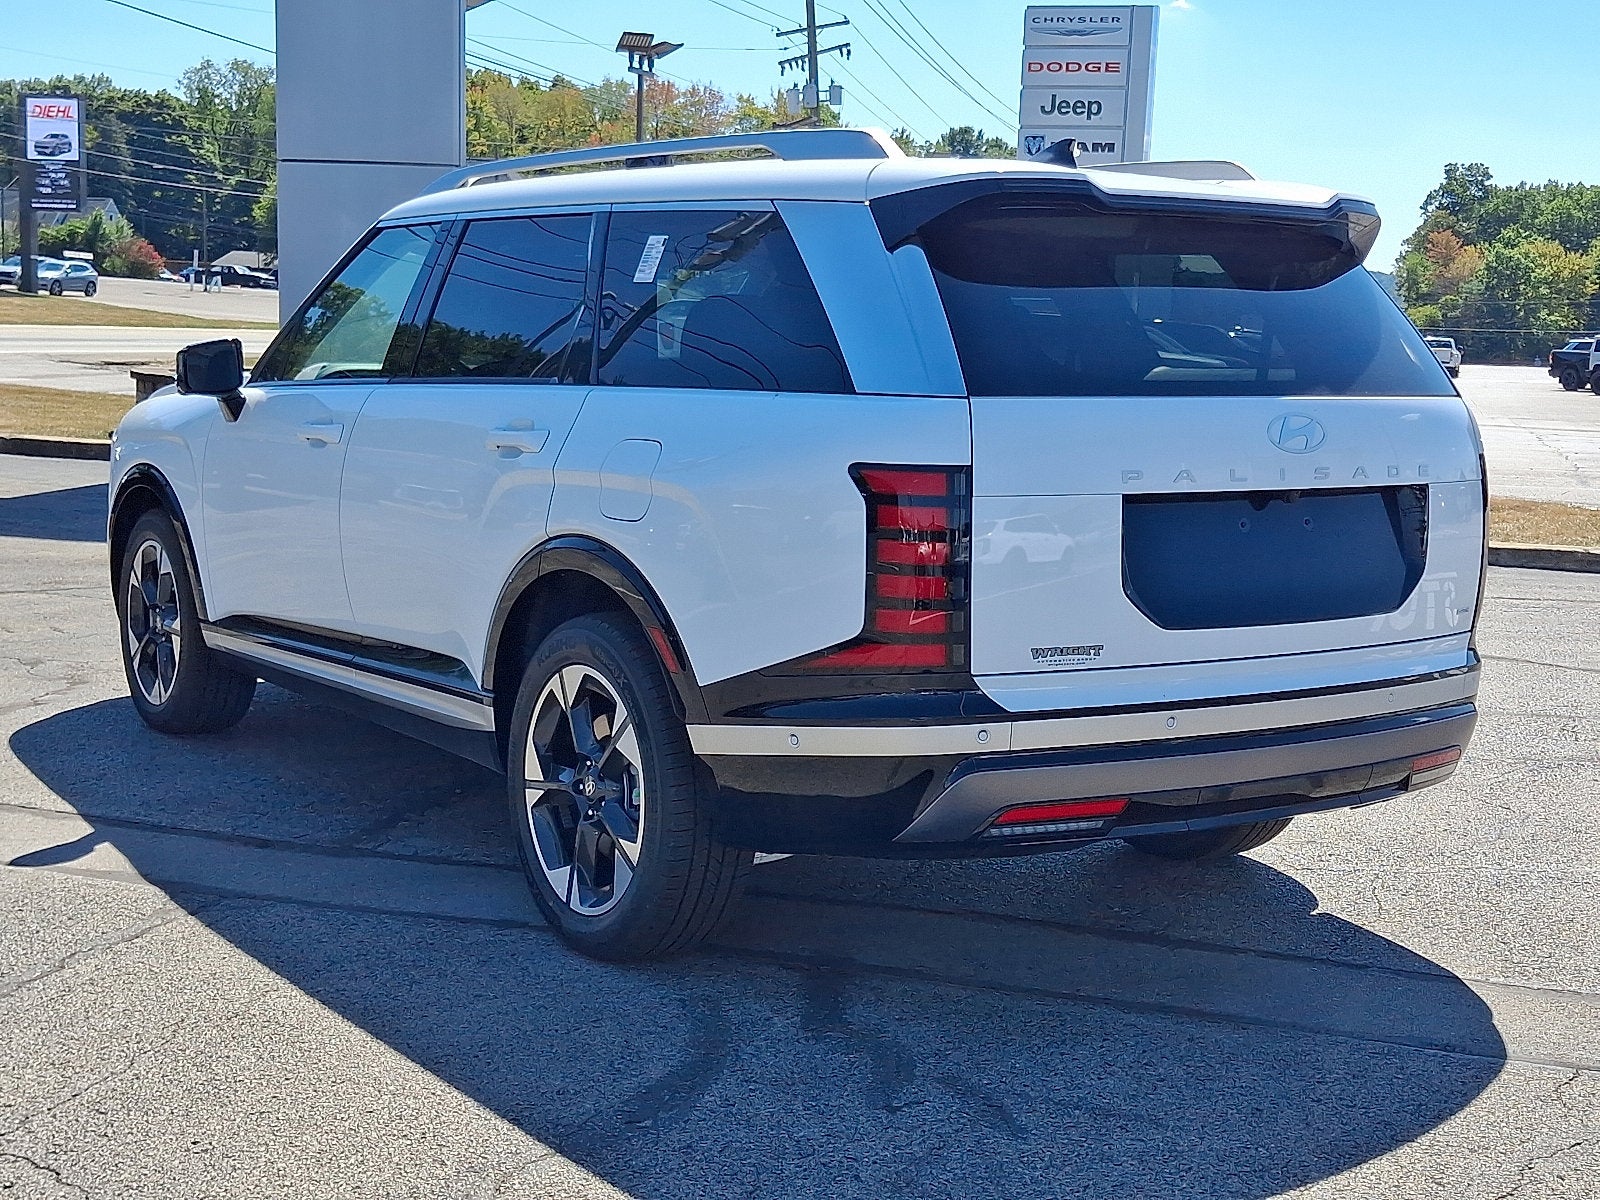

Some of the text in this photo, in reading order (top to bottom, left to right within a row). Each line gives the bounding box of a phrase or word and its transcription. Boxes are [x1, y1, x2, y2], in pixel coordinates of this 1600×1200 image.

[1032, 16, 1121, 24] CHRYSLER
[1027, 61, 1121, 73] DODGE
[31, 104, 75, 119] DIEHL
[1040, 94, 1103, 120] Jeep
[1050, 142, 1116, 153] AM
[1121, 465, 1431, 484] PALISADE
[1031, 645, 1104, 659] WRIGHT
